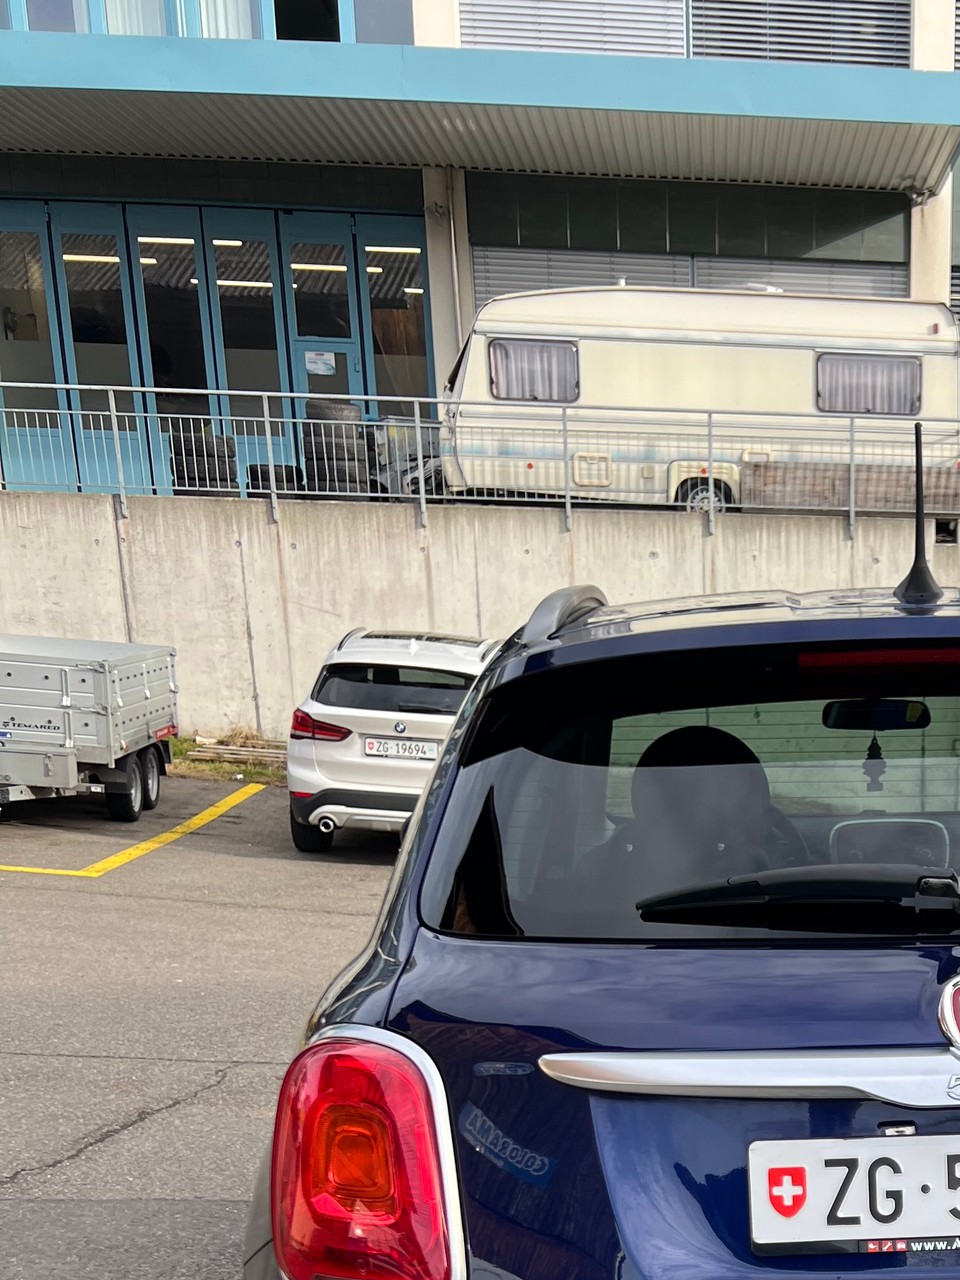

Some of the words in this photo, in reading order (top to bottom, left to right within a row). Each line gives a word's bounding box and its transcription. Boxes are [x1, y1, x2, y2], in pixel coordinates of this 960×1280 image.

[376, 741, 389, 753] ZG
[395, 743, 427, 755] 19694
[823, 1155, 904, 1227] ZG
